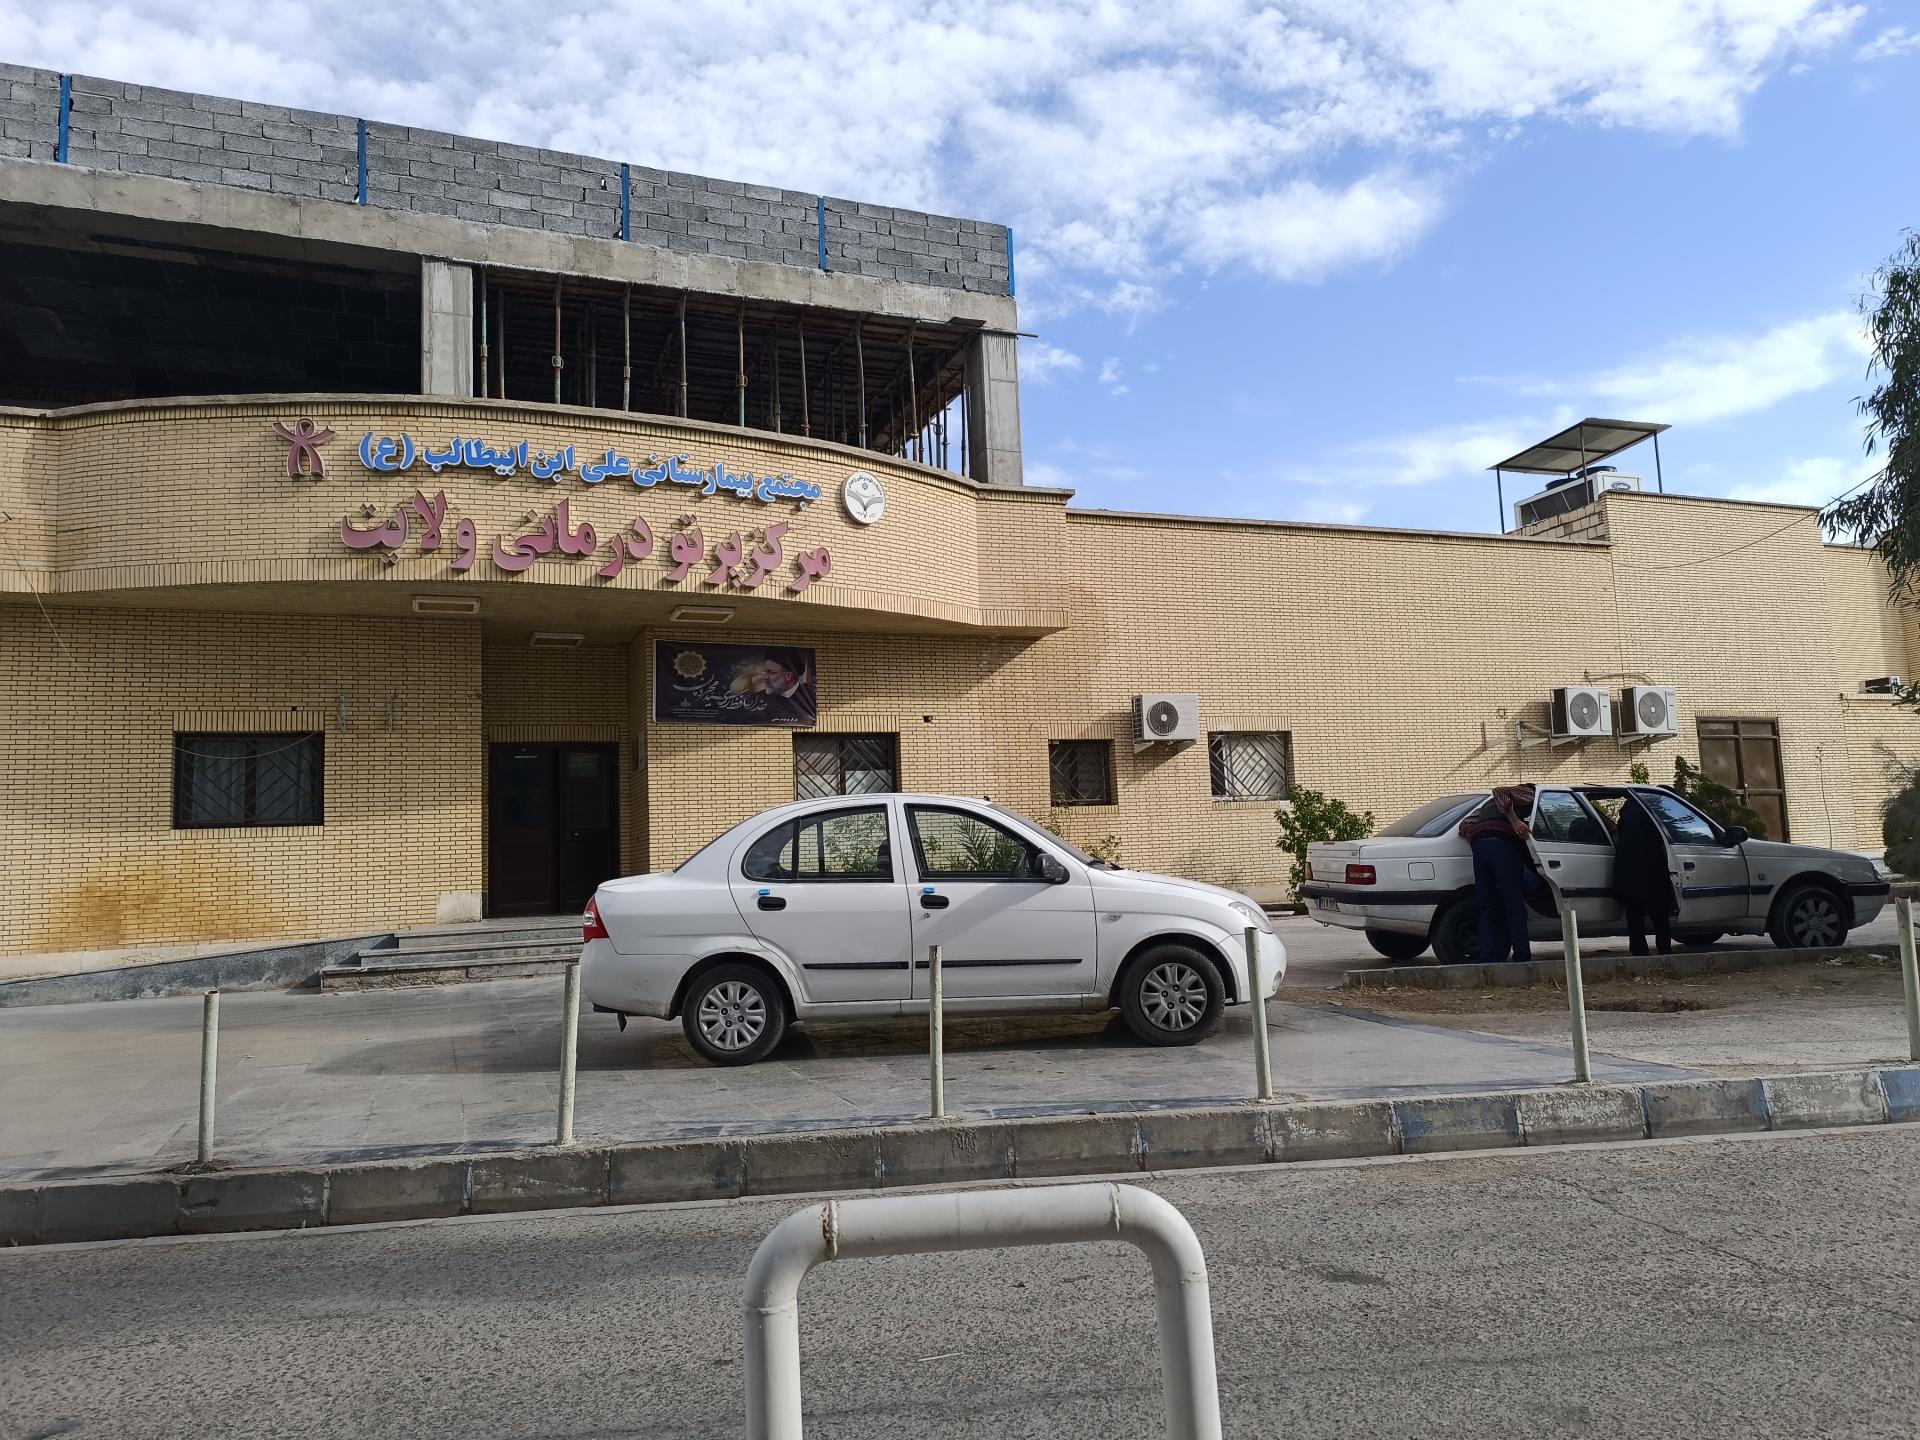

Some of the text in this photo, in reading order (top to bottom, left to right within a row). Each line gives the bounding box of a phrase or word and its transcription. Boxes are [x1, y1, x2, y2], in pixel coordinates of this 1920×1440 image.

[359, 432, 416, 470] (ع)
[423, 436, 528, 475] ابیطالب
[531, 444, 575, 482] ابن
[580, 448, 630, 482] علی
[633, 453, 754, 498] بیمارستانی
[757, 473, 821, 511] مجتمع
[341, 489, 476, 571] ولایت
[742, 521, 831, 592] مرکز
